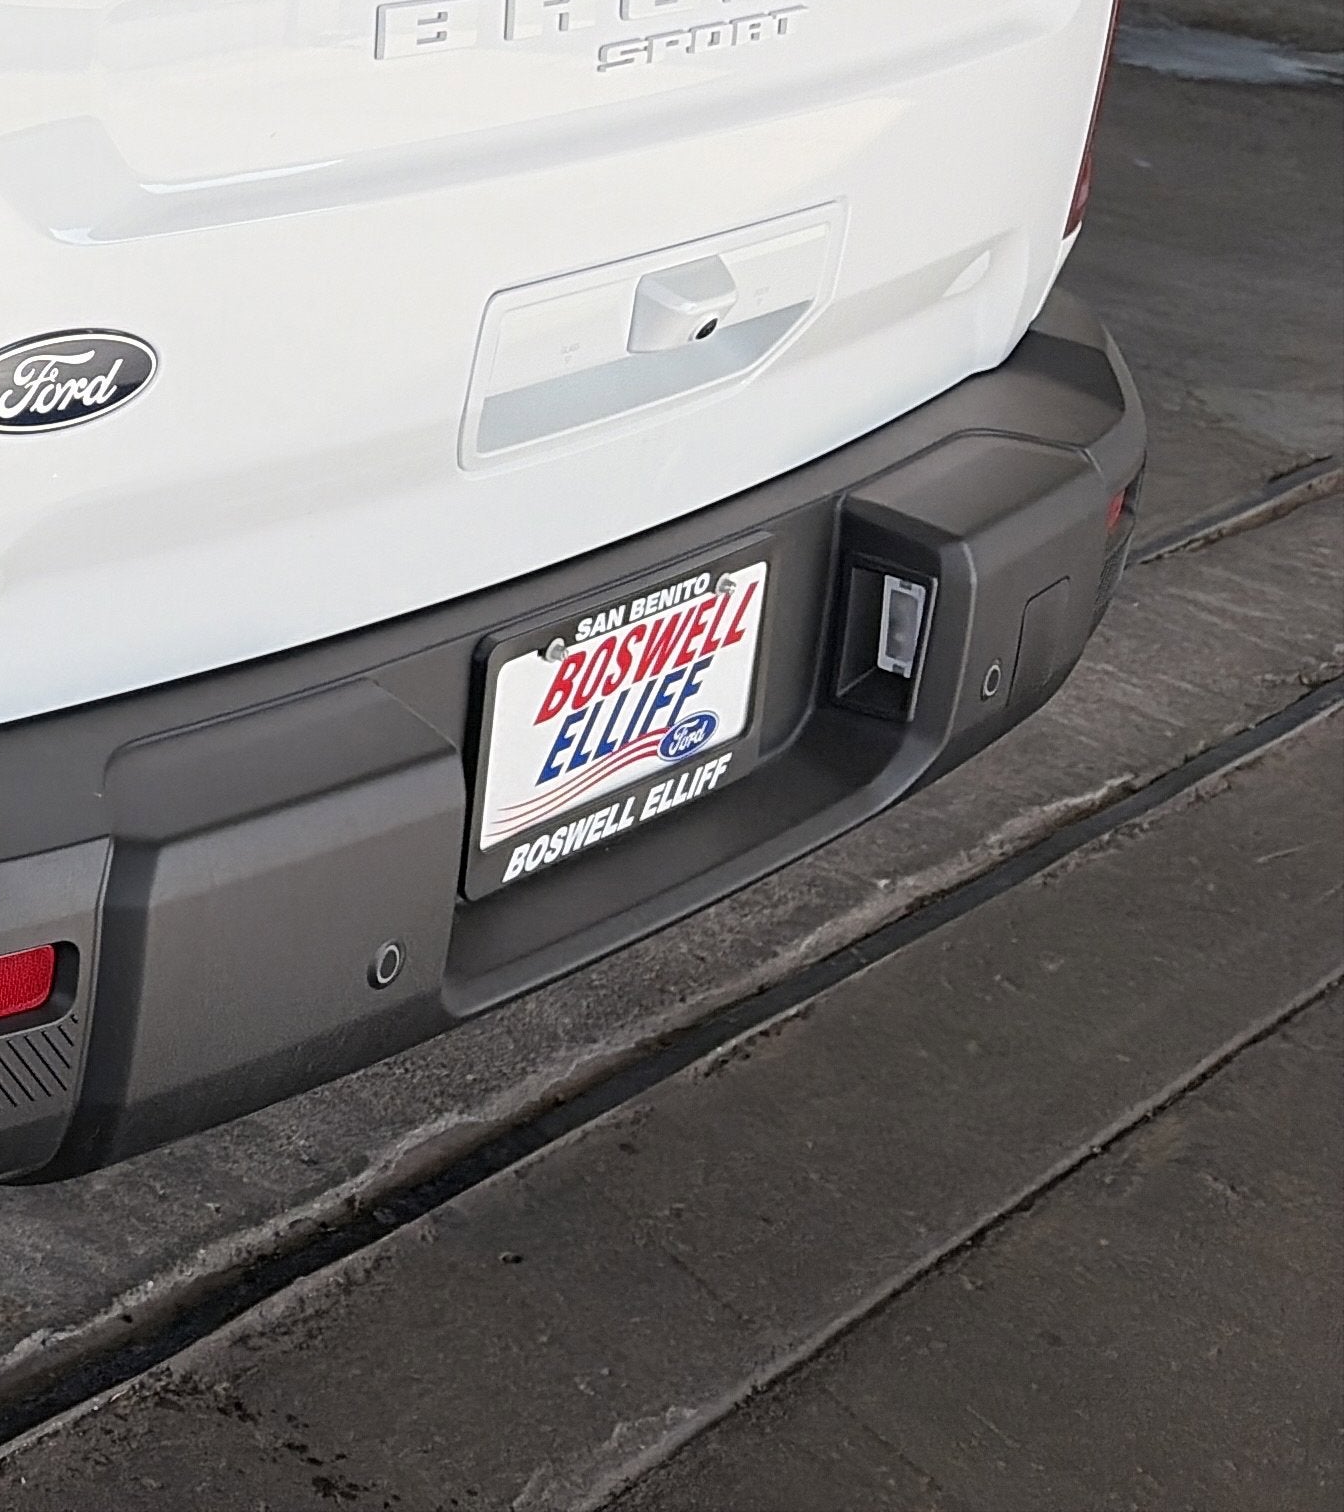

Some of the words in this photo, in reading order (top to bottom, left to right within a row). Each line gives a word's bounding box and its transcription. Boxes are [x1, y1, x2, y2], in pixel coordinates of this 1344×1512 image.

[596, 4, 809, 73] SPORT
[533, 580, 760, 727] BOSWELL
[575, 606, 626, 641] SAN
[628, 571, 711, 626] BENITO
[535, 658, 713, 787] ELLIFF
[668, 724, 710, 757] Ford
[501, 795, 637, 884] BOSWELL
[639, 751, 733, 821] ELLIFF
